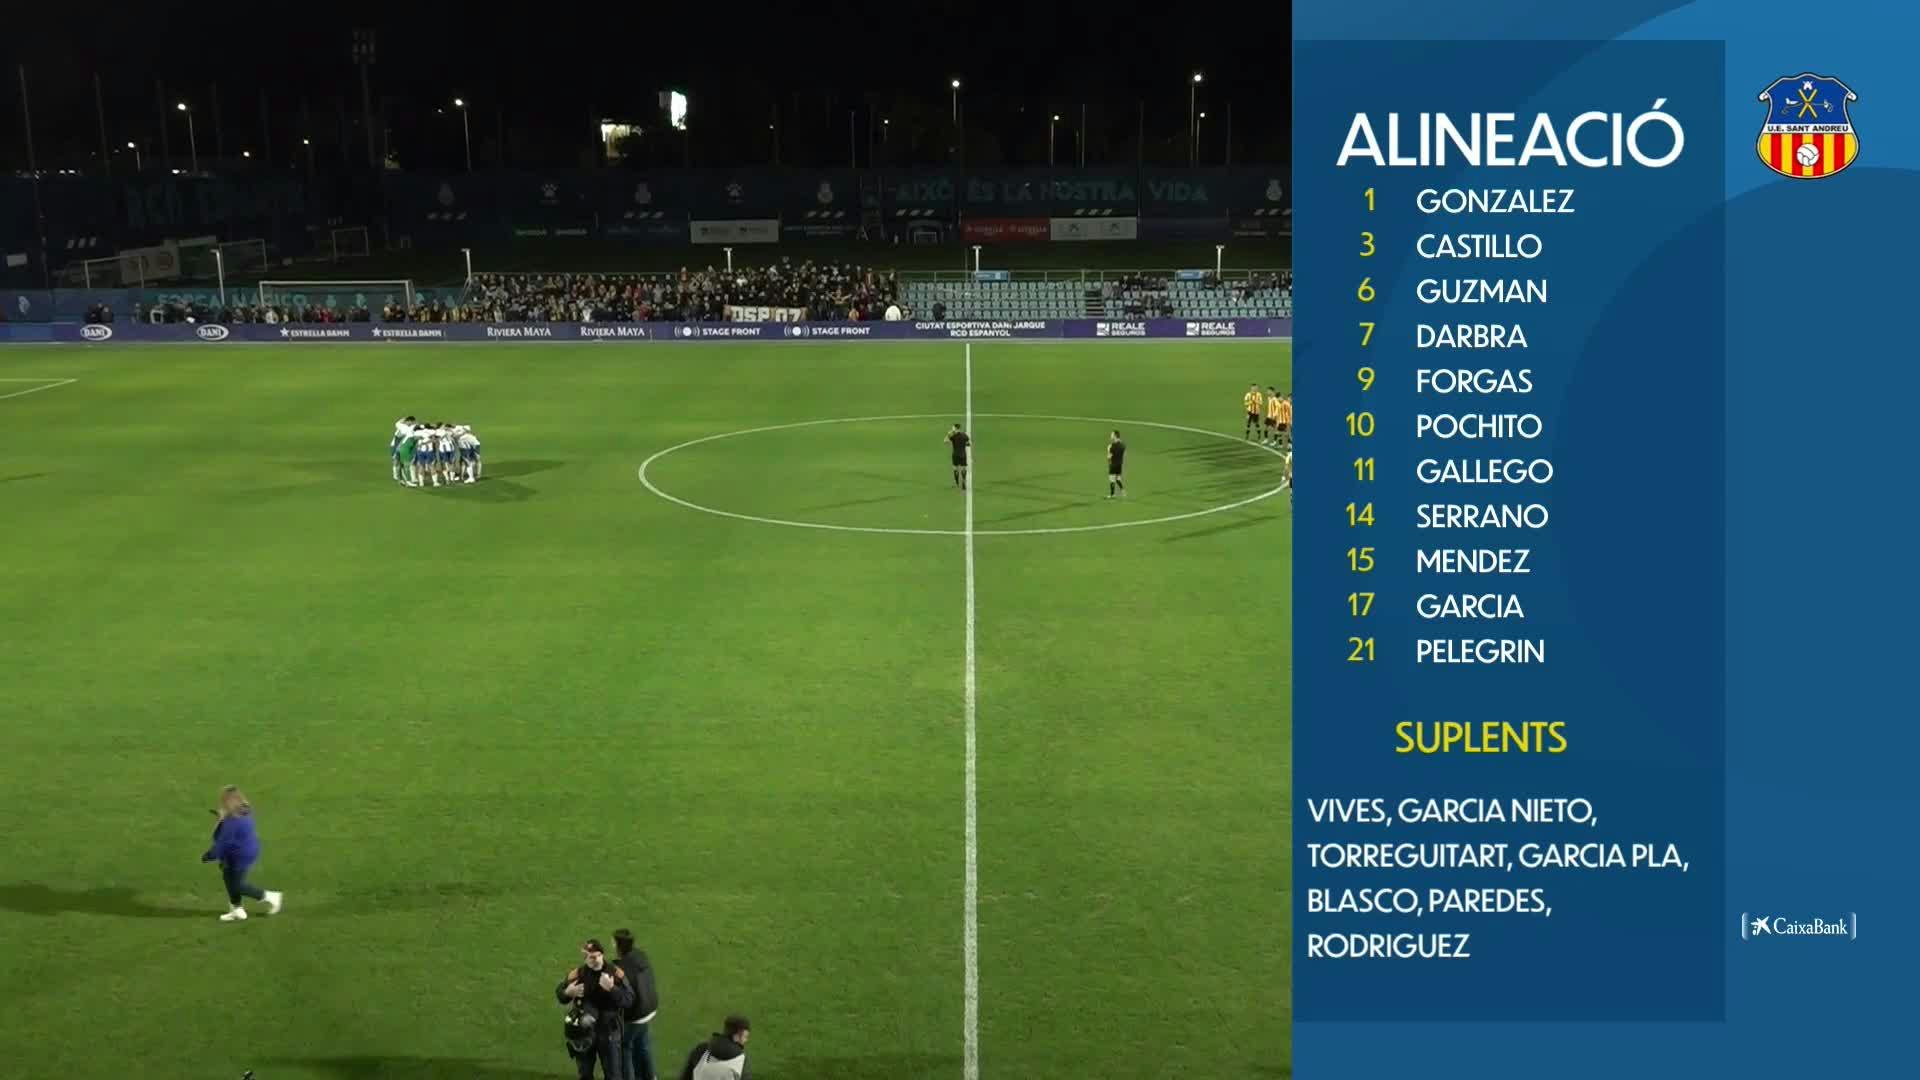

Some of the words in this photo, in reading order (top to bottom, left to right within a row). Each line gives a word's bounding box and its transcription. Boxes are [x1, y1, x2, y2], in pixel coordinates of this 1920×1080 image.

[1149, 183, 1208, 201] VIDA
[915, 321, 945, 329] CIUTAT
[946, 321, 991, 329] ESPORTIVA
[1013, 321, 1045, 329] JARQUE
[1111, 322, 1146, 330] REALE
[1201, 322, 1235, 330] REALE
[84, 328, 106, 337] DANI
[200, 328, 222, 337] DANI
[290, 329, 326, 337] ESTRELLA
[327, 329, 350, 337] DAMM
[382, 329, 418, 337] ESTRELLA
[418, 329, 442, 337] DAMM
[487, 326, 522, 337] RIVIERA
[524, 326, 552, 337] MAYA
[581, 326, 616, 337] RIVIERA
[617, 326, 645, 337] MAYA
[702, 327, 730, 336] STAGE
[731, 327, 761, 336] FRONT
[812, 327, 840, 336] STAGE
[841, 327, 870, 336] FRONT
[950, 329, 968, 337] RCD
[969, 329, 1011, 337] ESPANYOL
